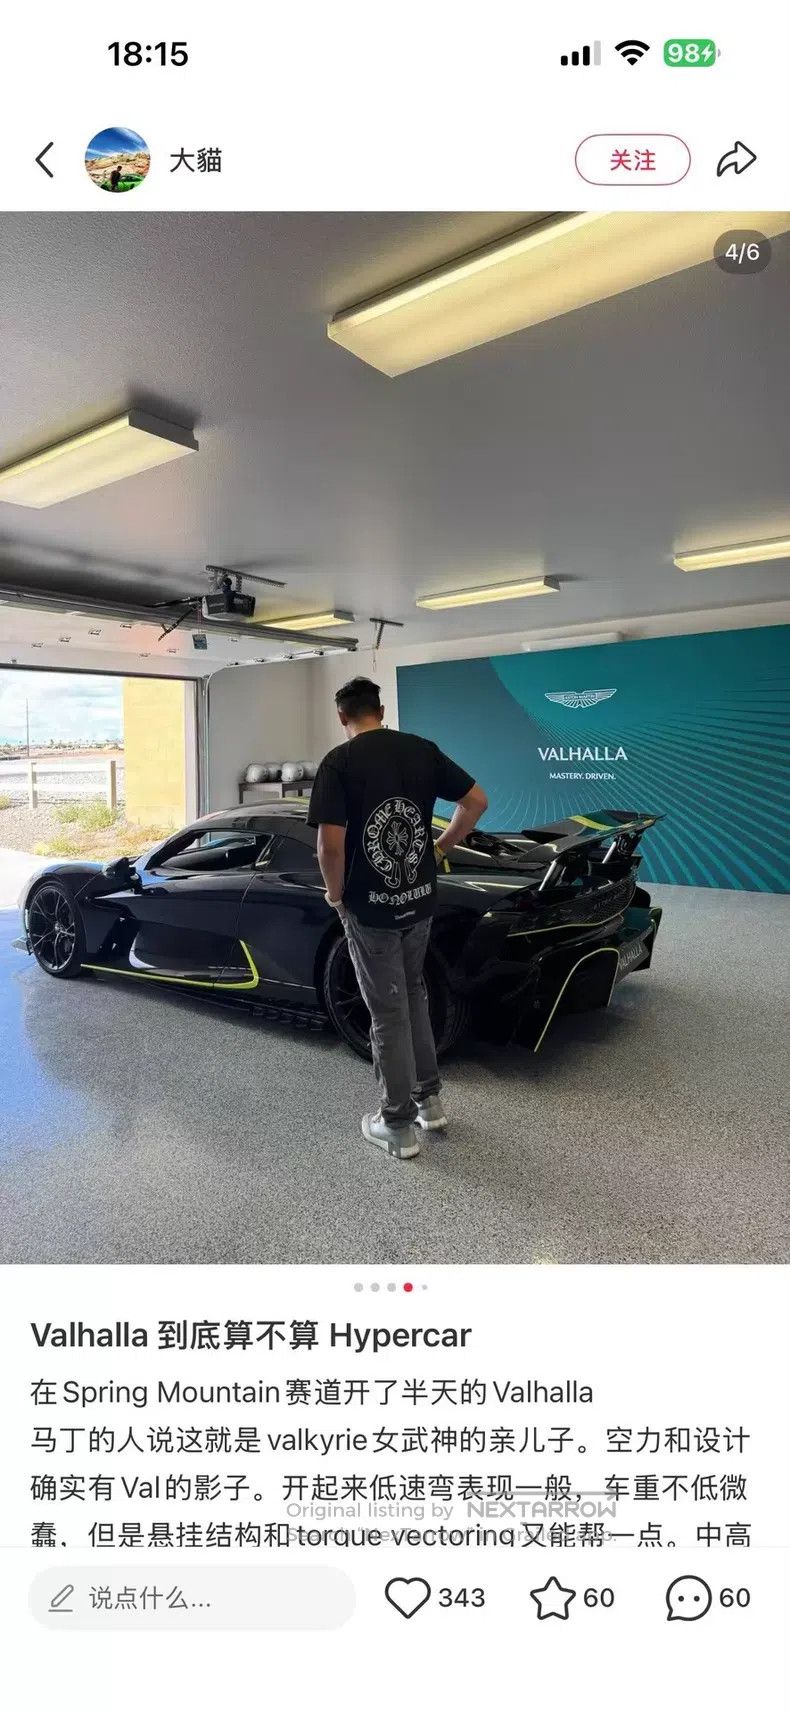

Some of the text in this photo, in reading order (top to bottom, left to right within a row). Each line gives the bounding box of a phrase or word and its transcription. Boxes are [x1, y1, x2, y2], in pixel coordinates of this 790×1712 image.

[537, 746, 629, 761] VALHALLA
[549, 772, 617, 780] MASTERY. DRIVEN.
